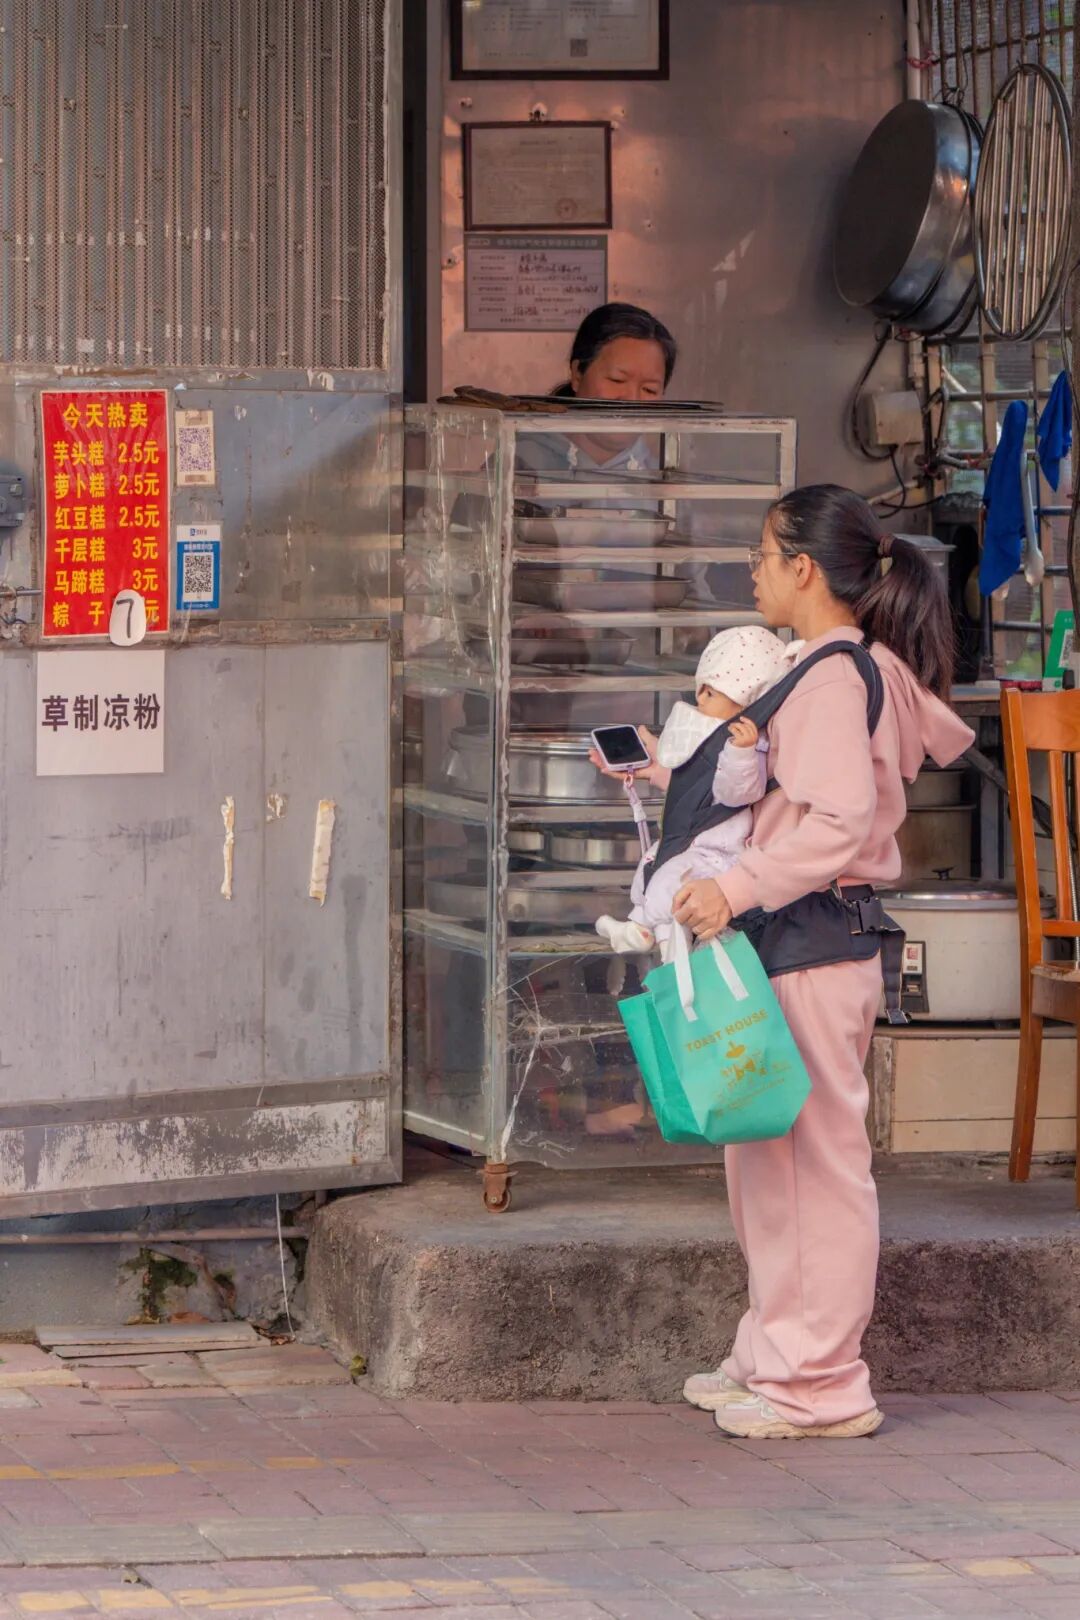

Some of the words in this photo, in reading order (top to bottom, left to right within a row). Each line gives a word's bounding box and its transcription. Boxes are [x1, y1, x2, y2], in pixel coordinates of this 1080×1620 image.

[62, 402, 148, 428] 今天热卖
[53, 440, 105, 466] 芋头糕
[118, 441, 159, 464] 2.5元
[54, 472, 105, 499] 萝卜糕
[118, 473, 160, 496] 2.5元
[55, 504, 106, 530] 红豆糕
[119, 504, 160, 528] 2.5元
[54, 536, 106, 564] 千层糕
[132, 536, 159, 560] 3元
[54, 568, 105, 595] 马蹄糕
[132, 568, 159, 592] 3元
[116, 598, 134, 639] 7
[41, 693, 161, 732] 草制凉粉
[725, 1008, 768, 1035] HOUSE
